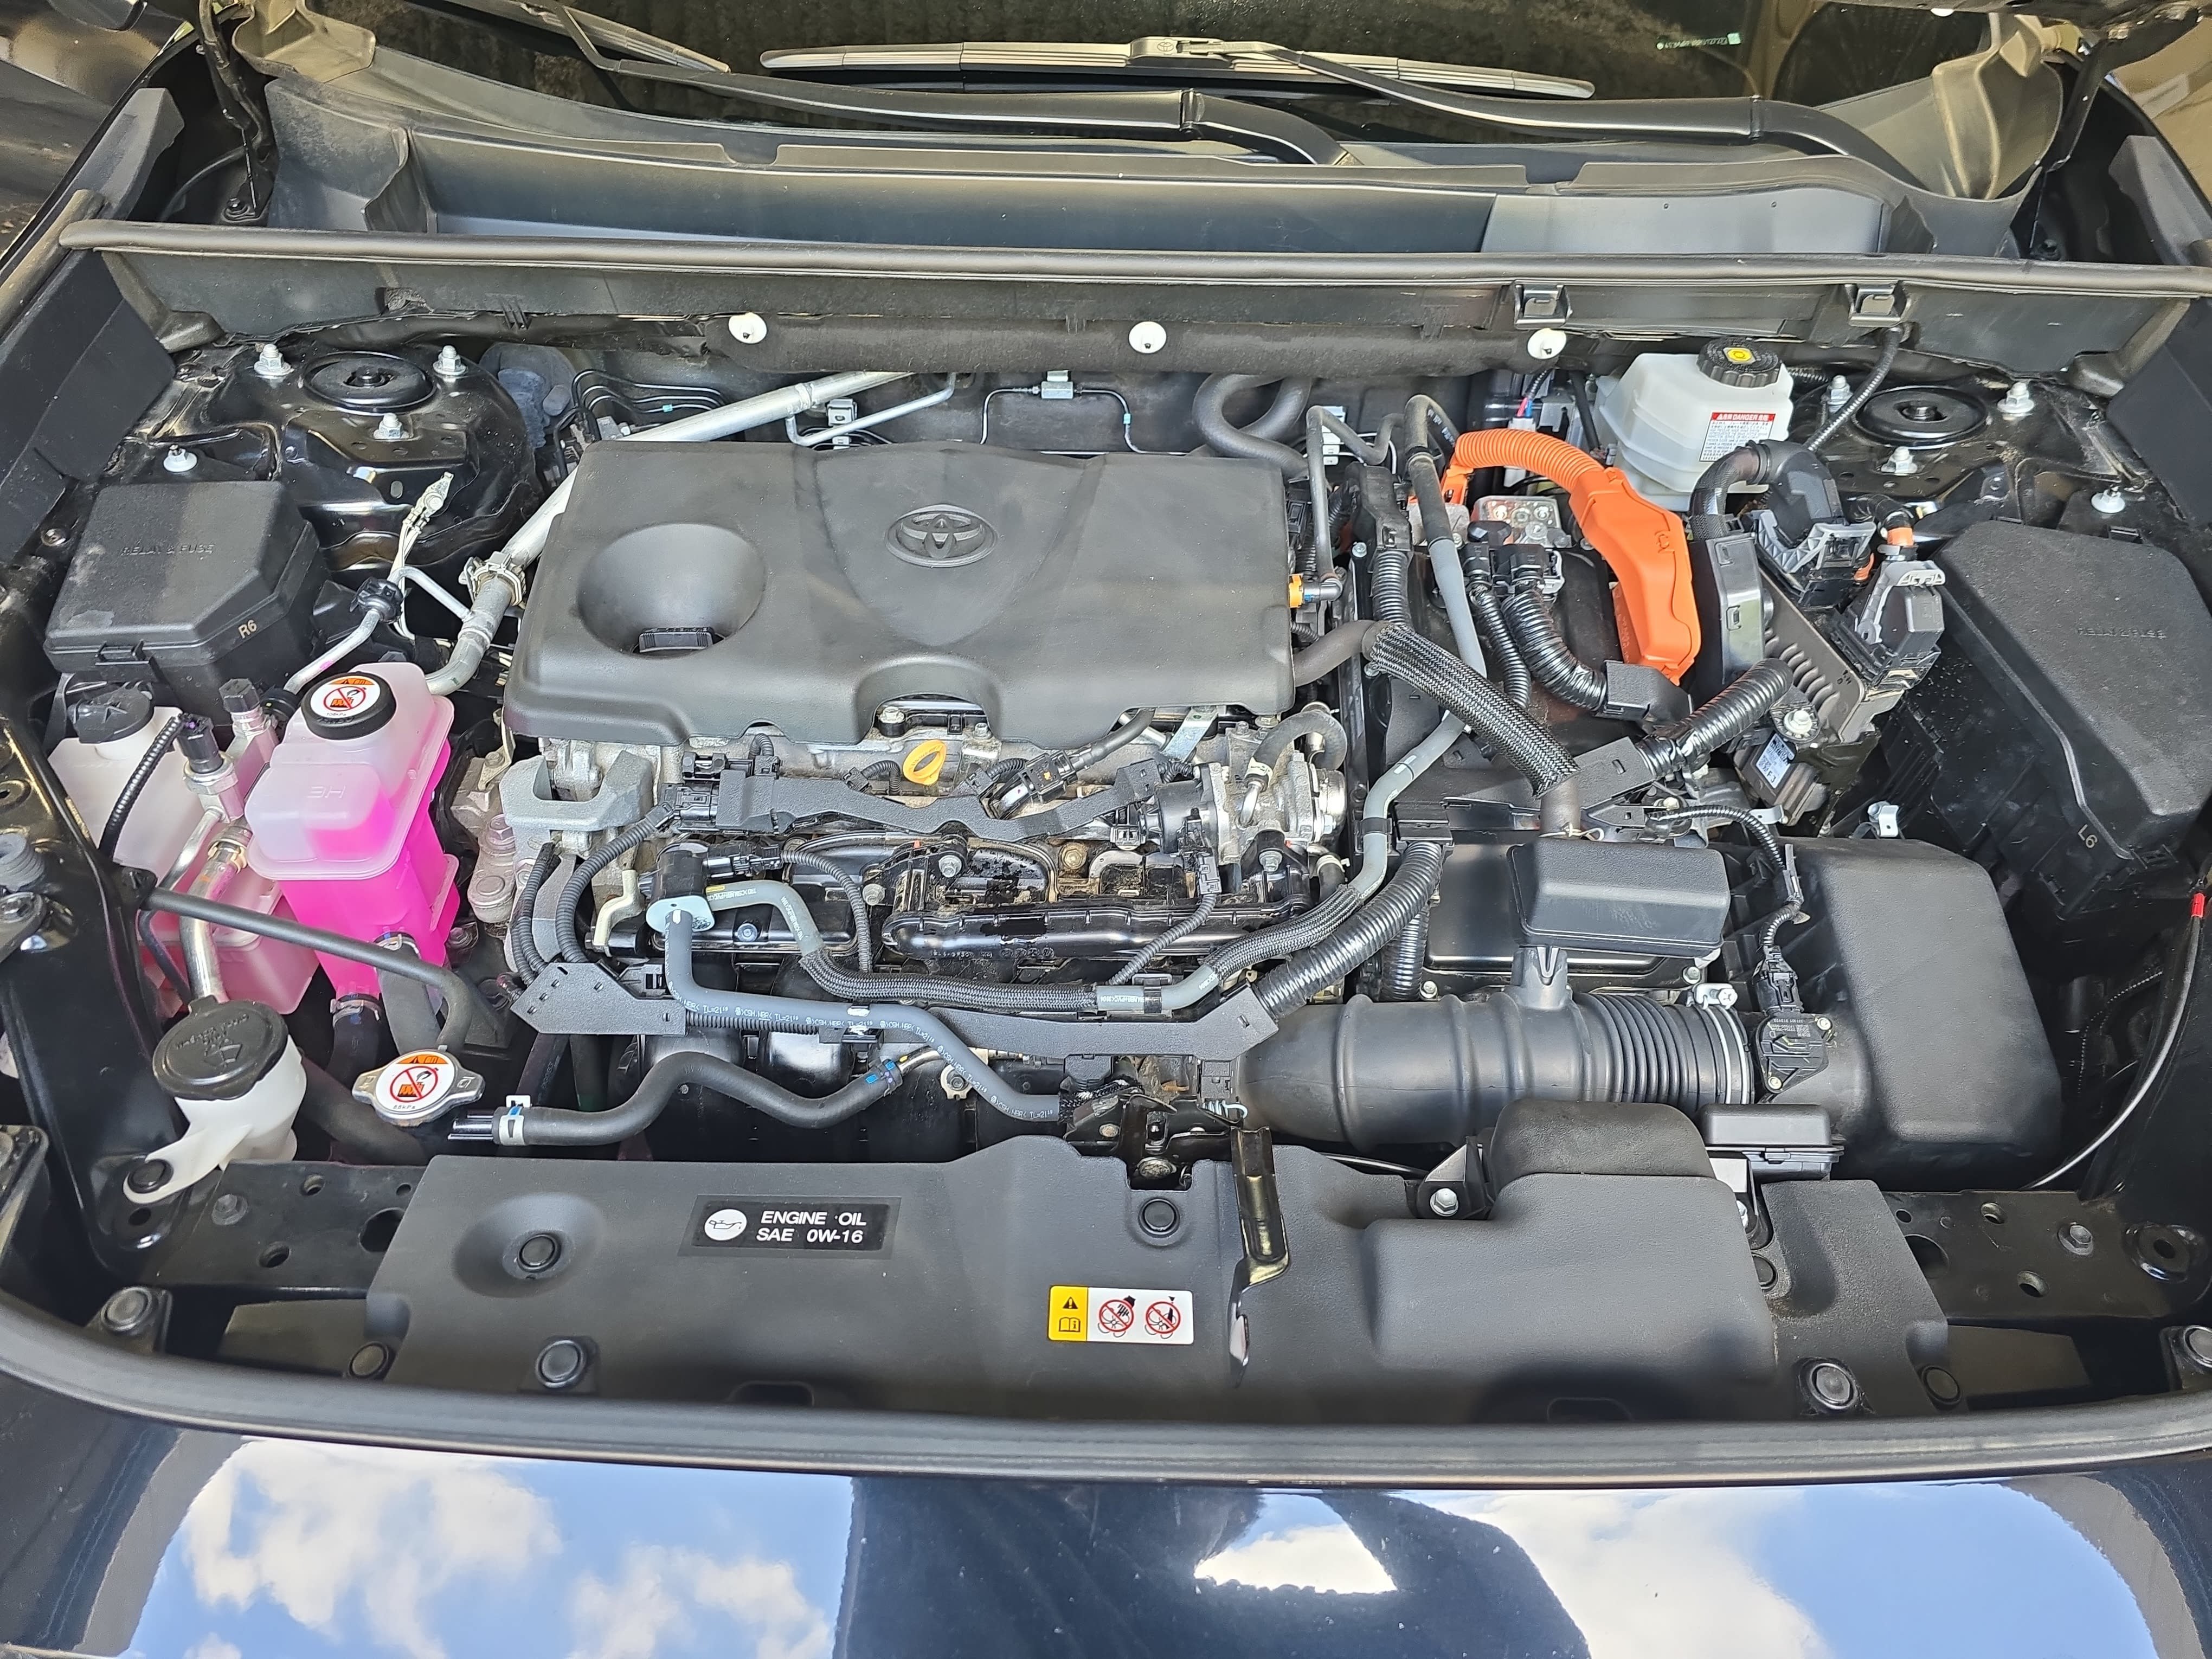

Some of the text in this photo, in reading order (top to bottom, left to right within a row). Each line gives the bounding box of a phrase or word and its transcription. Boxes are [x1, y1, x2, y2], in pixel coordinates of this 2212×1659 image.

[179, 544, 215, 554] FUSE
[239, 620, 257, 639] R6
[2078, 824, 2098, 848] L6
[761, 1211, 867, 1226] ENGINE OIL
[756, 1227, 863, 1243] SAE 0W-16
